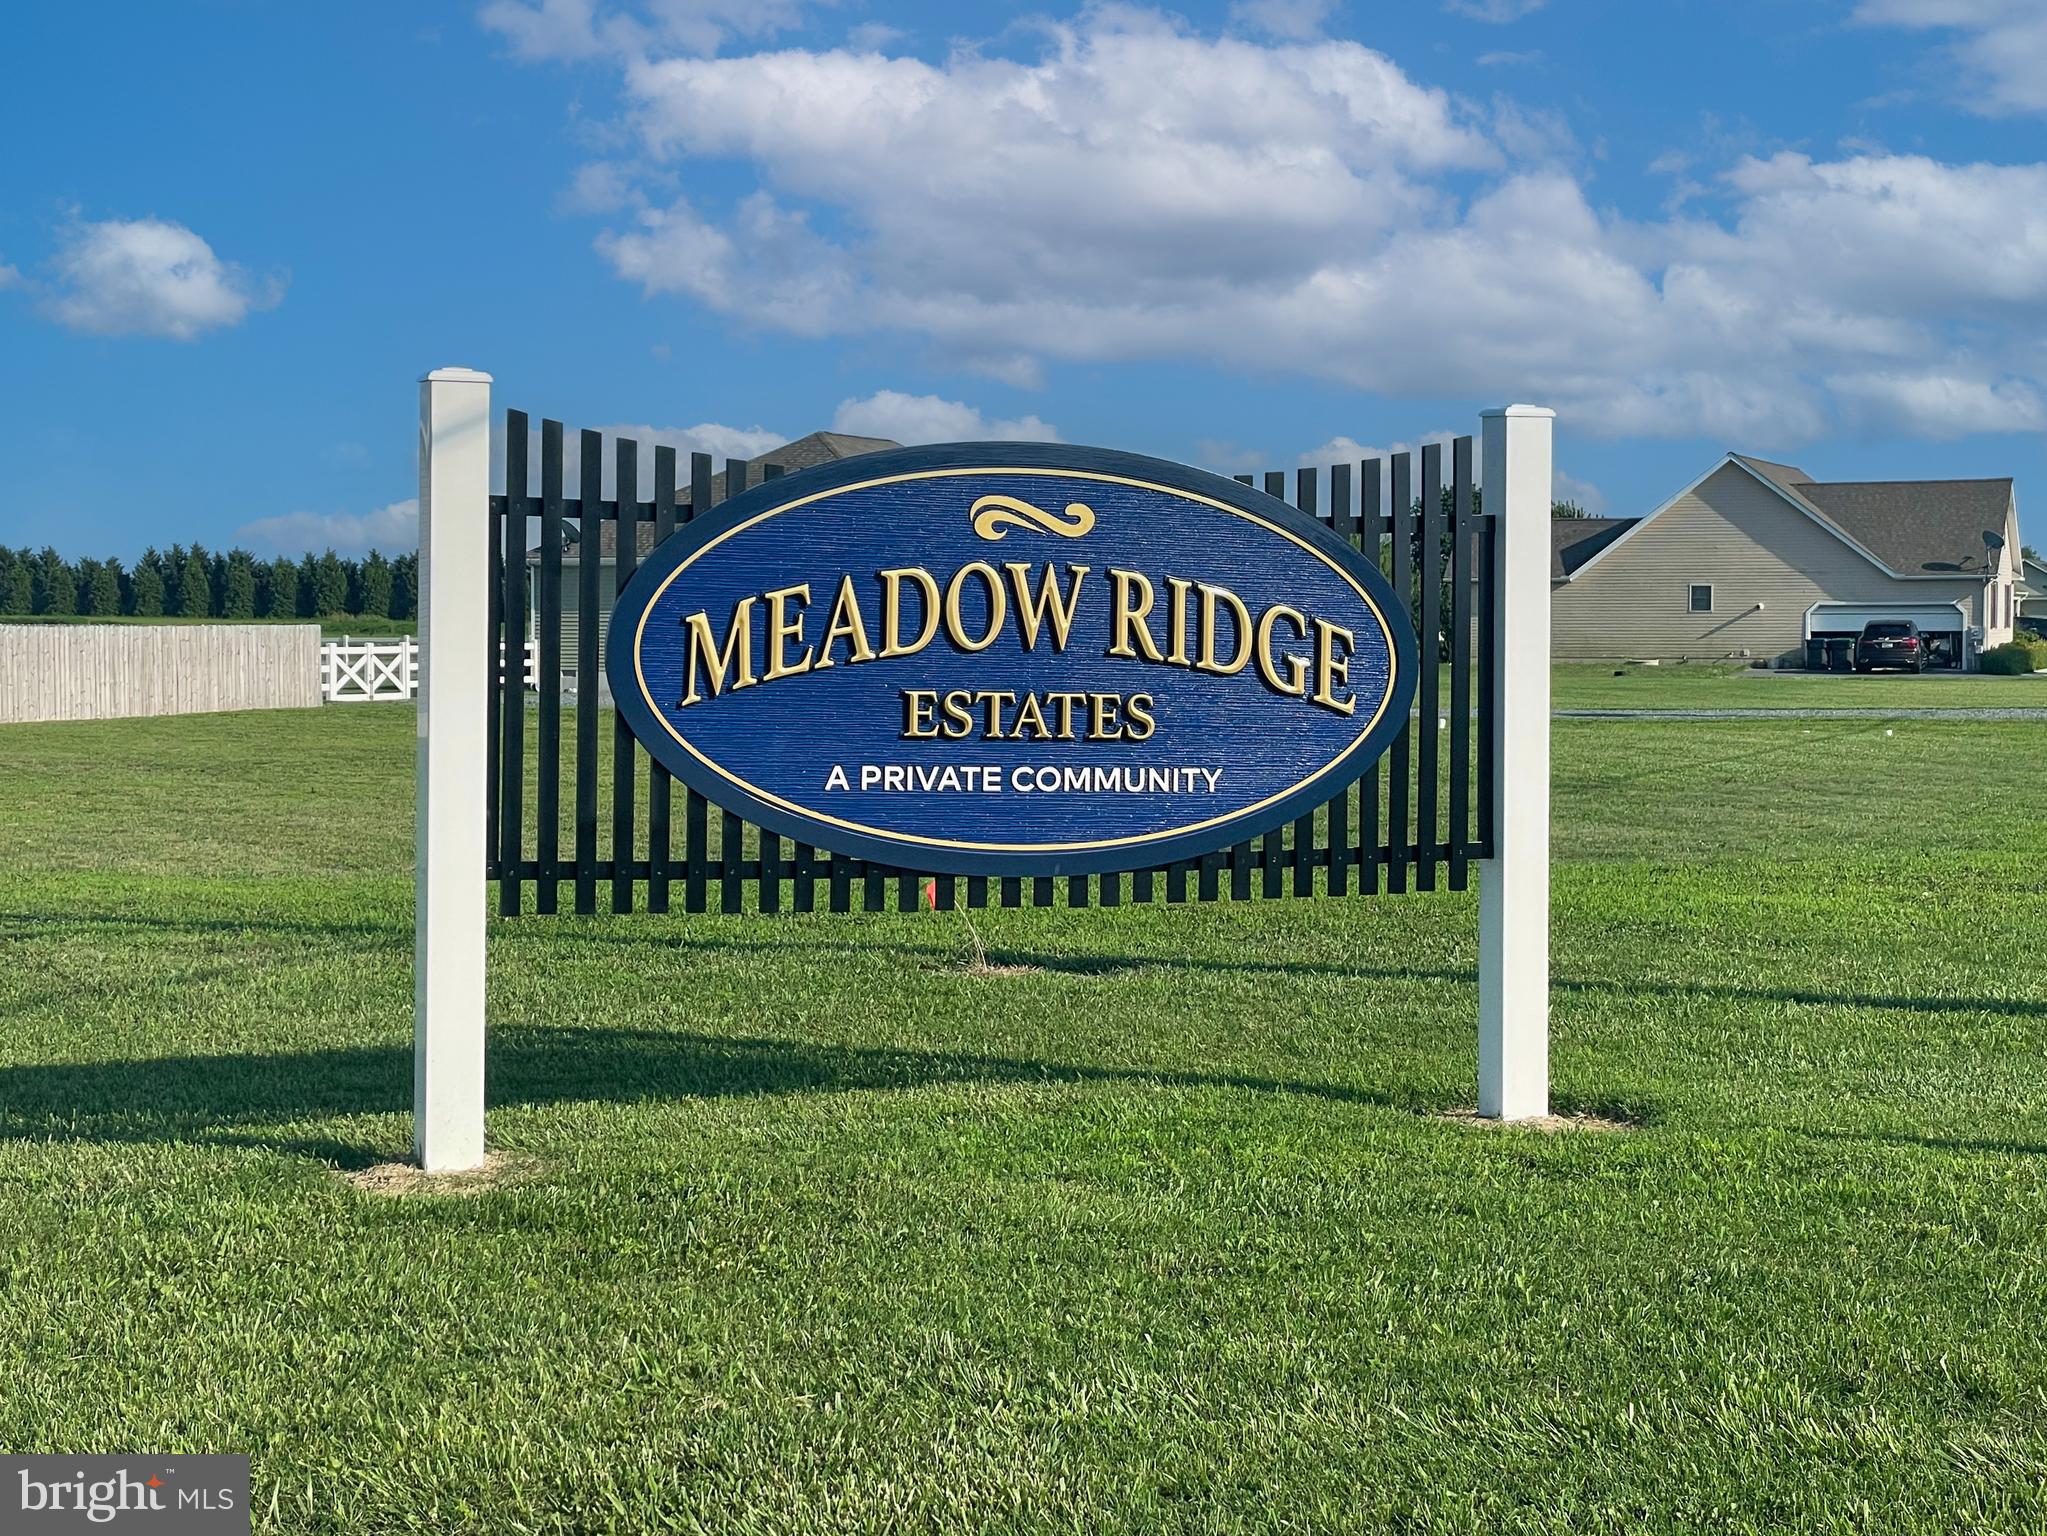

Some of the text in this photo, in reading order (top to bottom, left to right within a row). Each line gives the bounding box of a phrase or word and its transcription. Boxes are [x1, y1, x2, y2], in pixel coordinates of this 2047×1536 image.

[679, 561, 1358, 716] MEADOW RIDGE
[902, 690, 1156, 740] ESTATES
[824, 766, 1224, 793] A PRIVATE COMMUNITY
